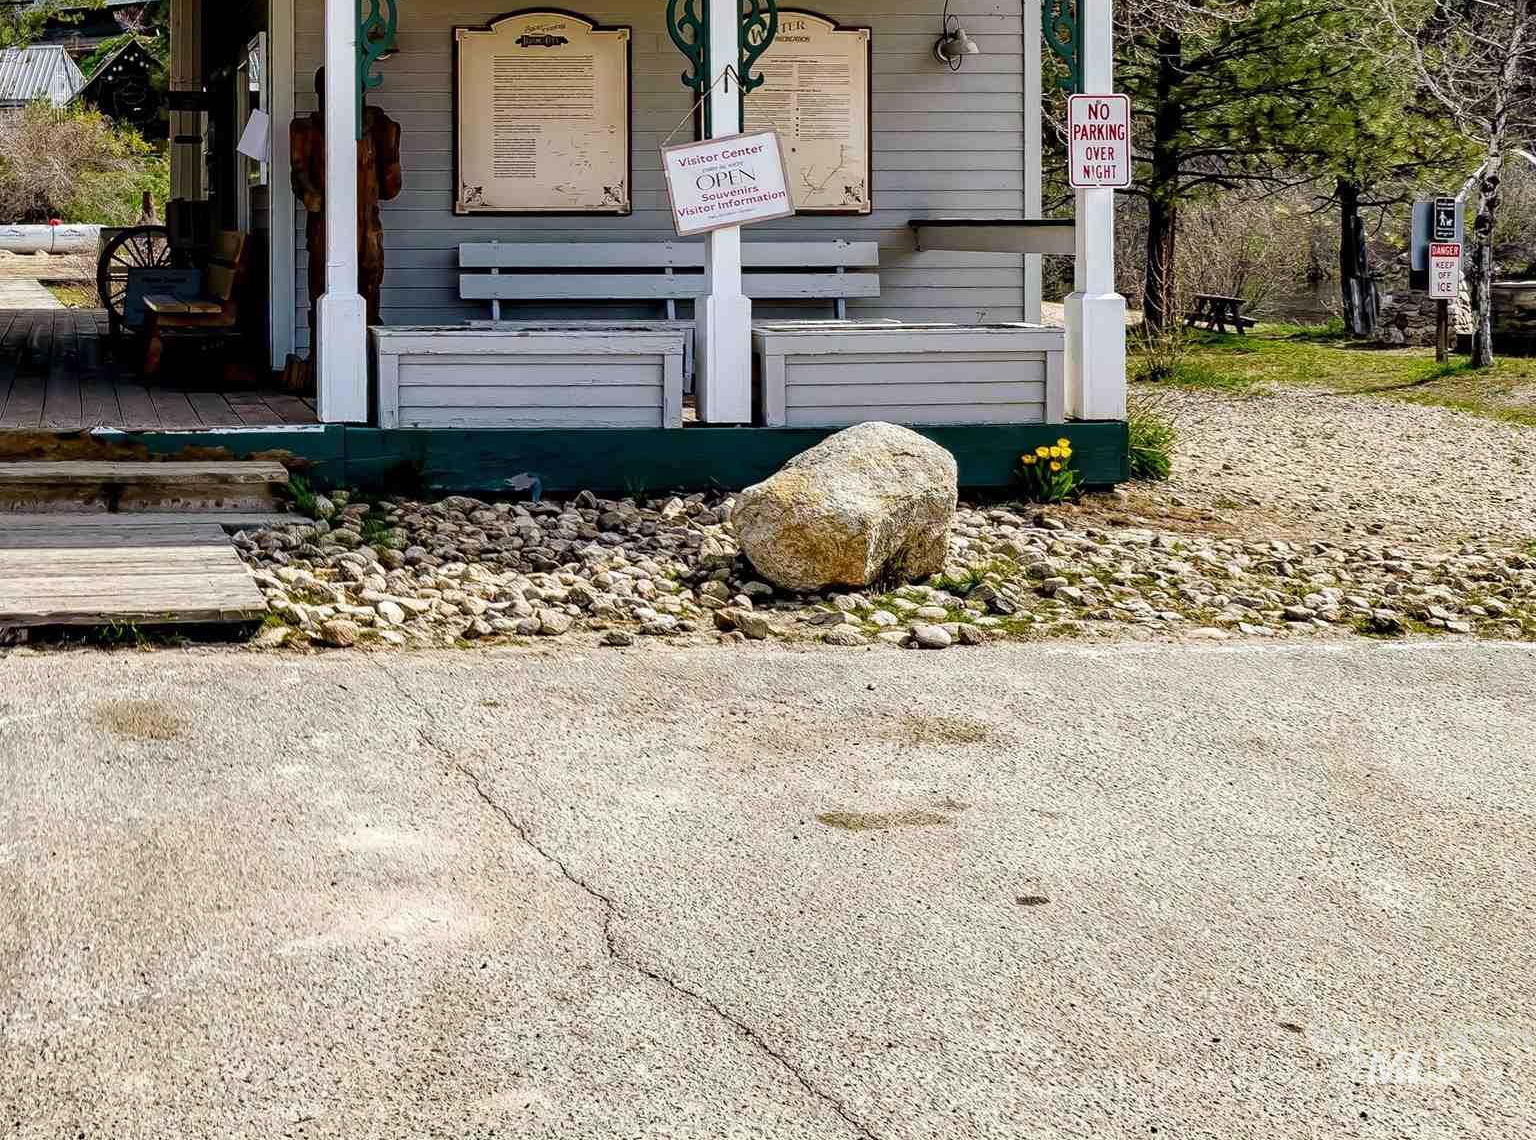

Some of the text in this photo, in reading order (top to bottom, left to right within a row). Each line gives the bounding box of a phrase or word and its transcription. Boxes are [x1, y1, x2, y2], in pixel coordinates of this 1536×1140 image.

[1087, 103, 1110, 120] NO
[1073, 123, 1125, 141] PARKING
[678, 154, 719, 167] Visitor
[721, 144, 764, 160] Center
[1085, 146, 1115, 161] OVER
[695, 167, 757, 191] OPEN
[1082, 164, 1117, 179] NIGHT
[701, 186, 760, 202] Souvenirs
[677, 204, 717, 217] Visitor
[717, 190, 786, 210] Information
[1432, 245, 1459, 256] DANGER
[1435, 261, 1456, 269] KEEP
[1438, 271, 1453, 280] OFF
[1437, 282, 1452, 292] ICE
